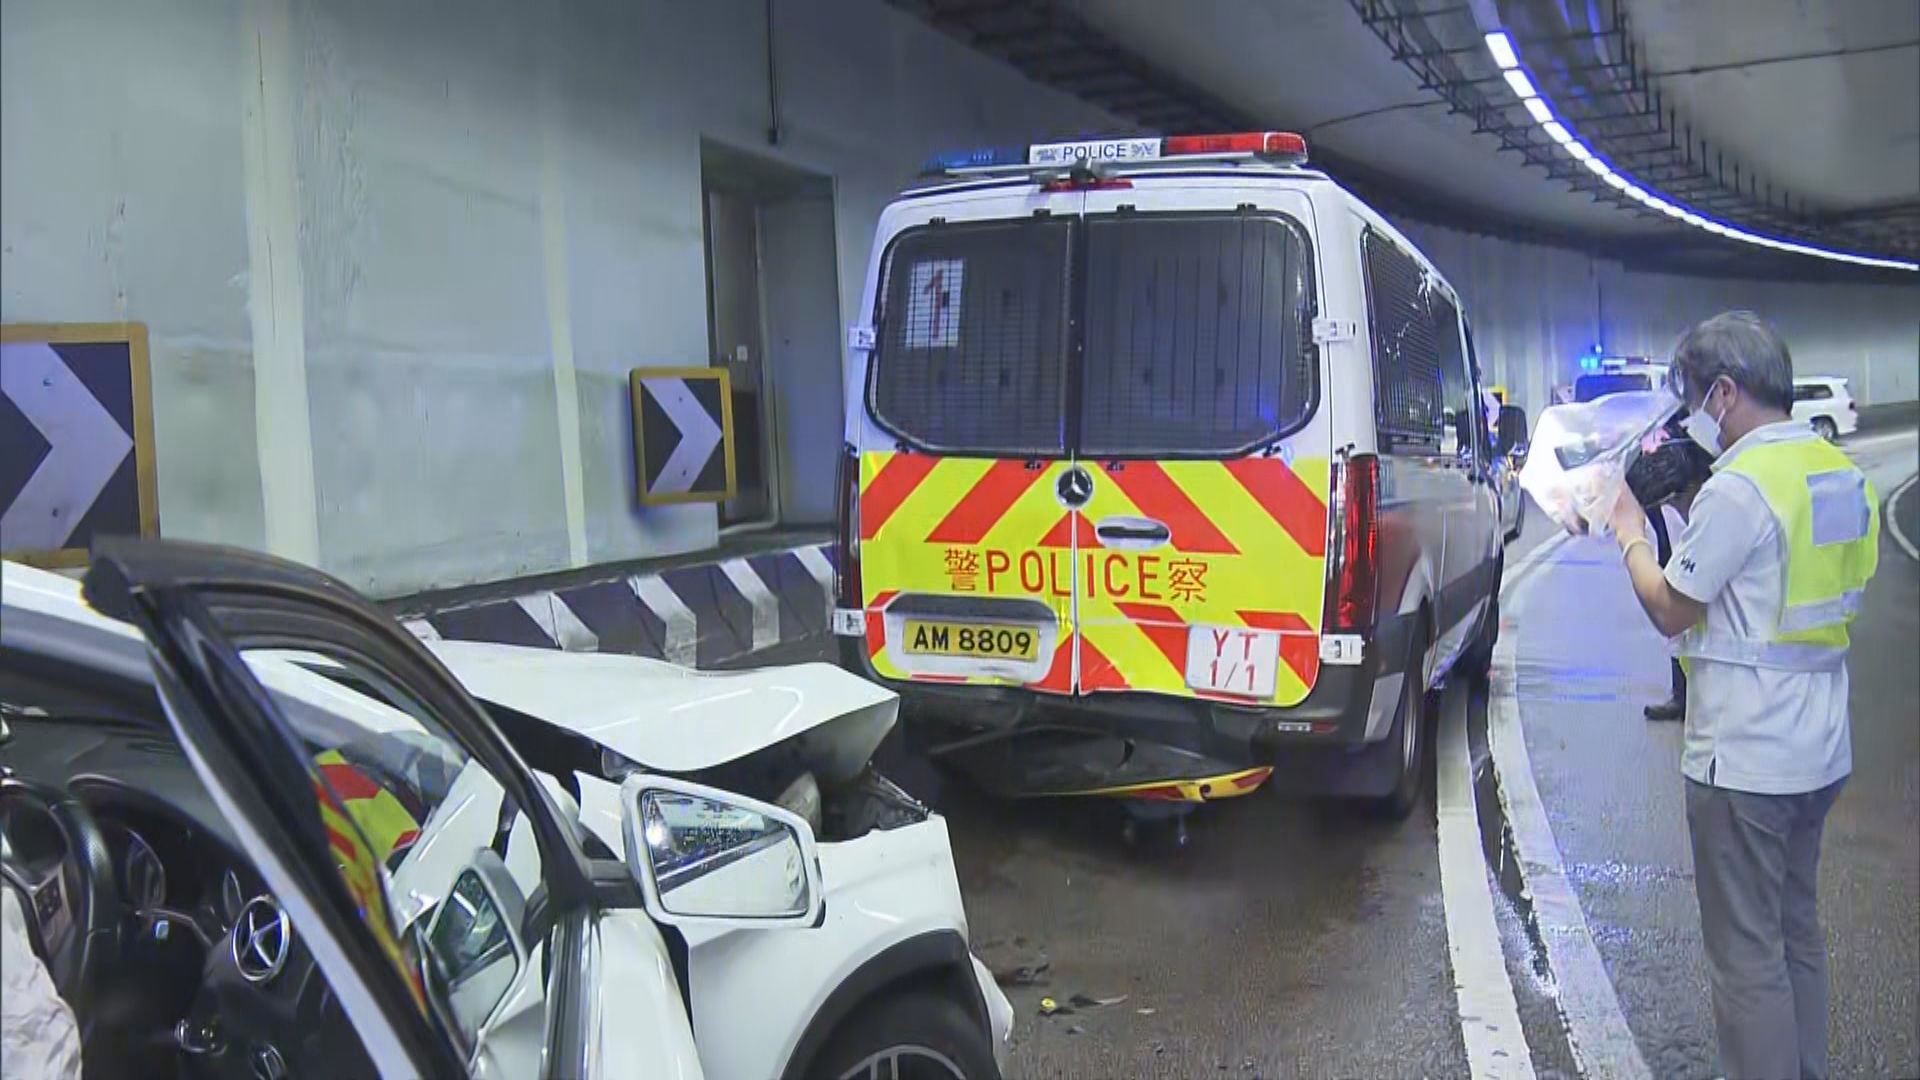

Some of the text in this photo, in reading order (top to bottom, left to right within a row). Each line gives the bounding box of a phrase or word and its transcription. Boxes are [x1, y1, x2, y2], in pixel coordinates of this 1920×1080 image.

[1062, 144, 1127, 161] POLICE
[944, 548, 1209, 602] 警 POLICE 察
[913, 625, 1032, 655] AM 8809
[1209, 660, 1257, 691] 1/1
